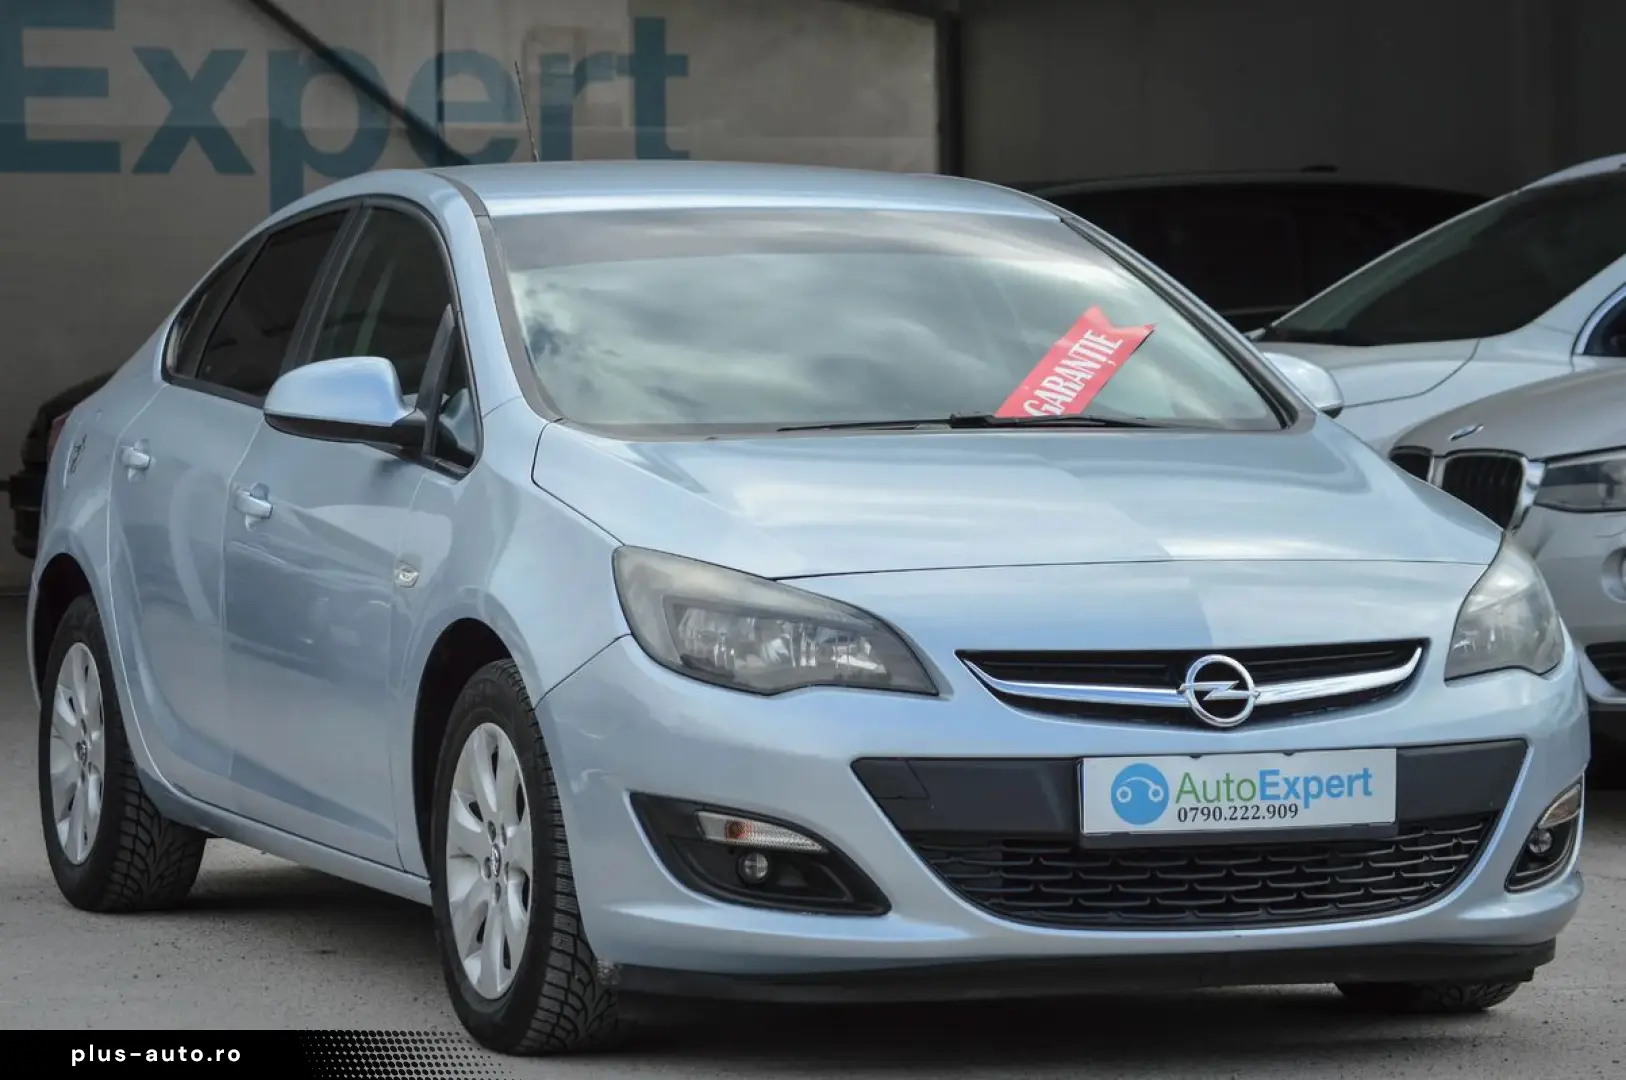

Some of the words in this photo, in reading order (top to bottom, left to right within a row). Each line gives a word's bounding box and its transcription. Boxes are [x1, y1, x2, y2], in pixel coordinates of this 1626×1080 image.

[0, 0, 691, 214] Expert
[1175, 767, 1373, 809] AutoExpert
[1177, 803, 1299, 823] 0790.222.909
